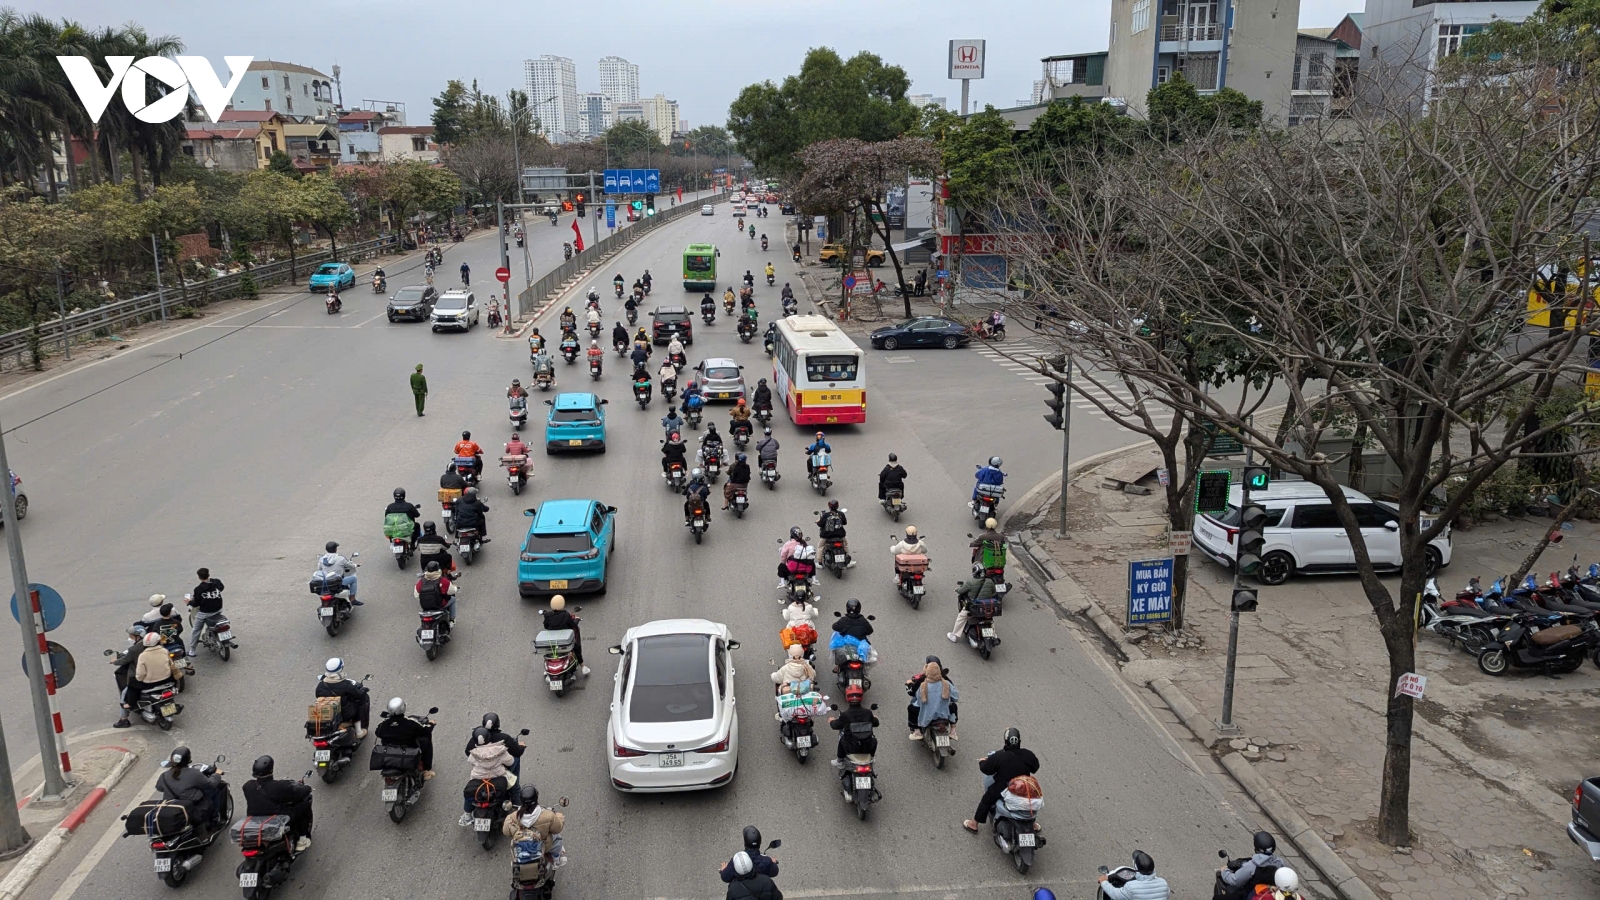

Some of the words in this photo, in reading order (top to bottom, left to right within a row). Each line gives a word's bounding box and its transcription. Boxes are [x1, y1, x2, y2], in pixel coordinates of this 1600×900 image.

[631, 201, 642, 210] 40
[1136, 569, 1151, 580] MUA
[1153, 567, 1168, 578] BÁN
[1137, 582, 1149, 593] KÝ
[1151, 579, 1167, 592] GỬI
[1132, 598, 1145, 612] XE
[1148, 594, 1170, 611] MÁY
